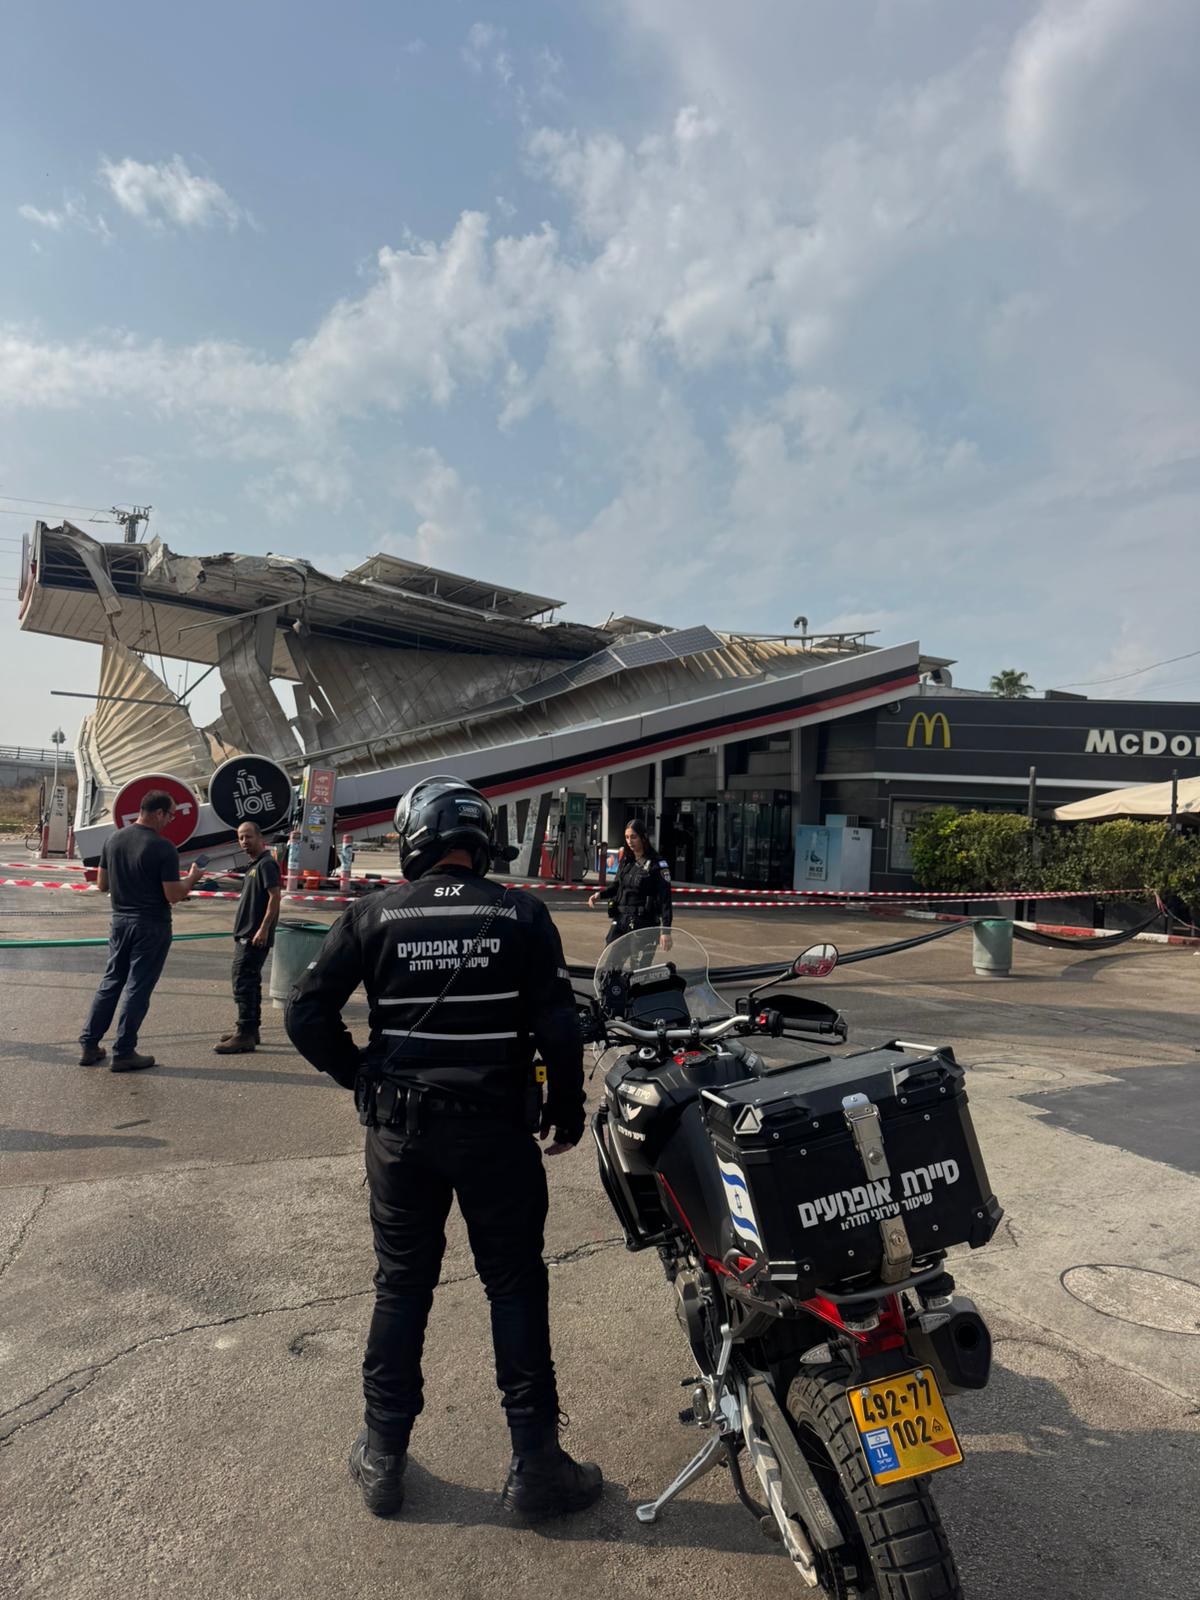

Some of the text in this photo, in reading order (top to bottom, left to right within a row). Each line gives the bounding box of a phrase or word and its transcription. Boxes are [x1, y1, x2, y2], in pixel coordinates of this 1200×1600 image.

[232, 791, 276, 819] JOE
[397, 940, 458, 958] אופנועים
[409, 959, 433, 972] חדרה
[900, 1159, 960, 1198] סיירת
[901, 1192, 933, 1211] שיטור
[871, 1202, 900, 1221] עירוני
[861, 1378, 932, 1423] 492-77
[892, 1415, 933, 1449] 102
[876, 1447, 888, 1459] IL
